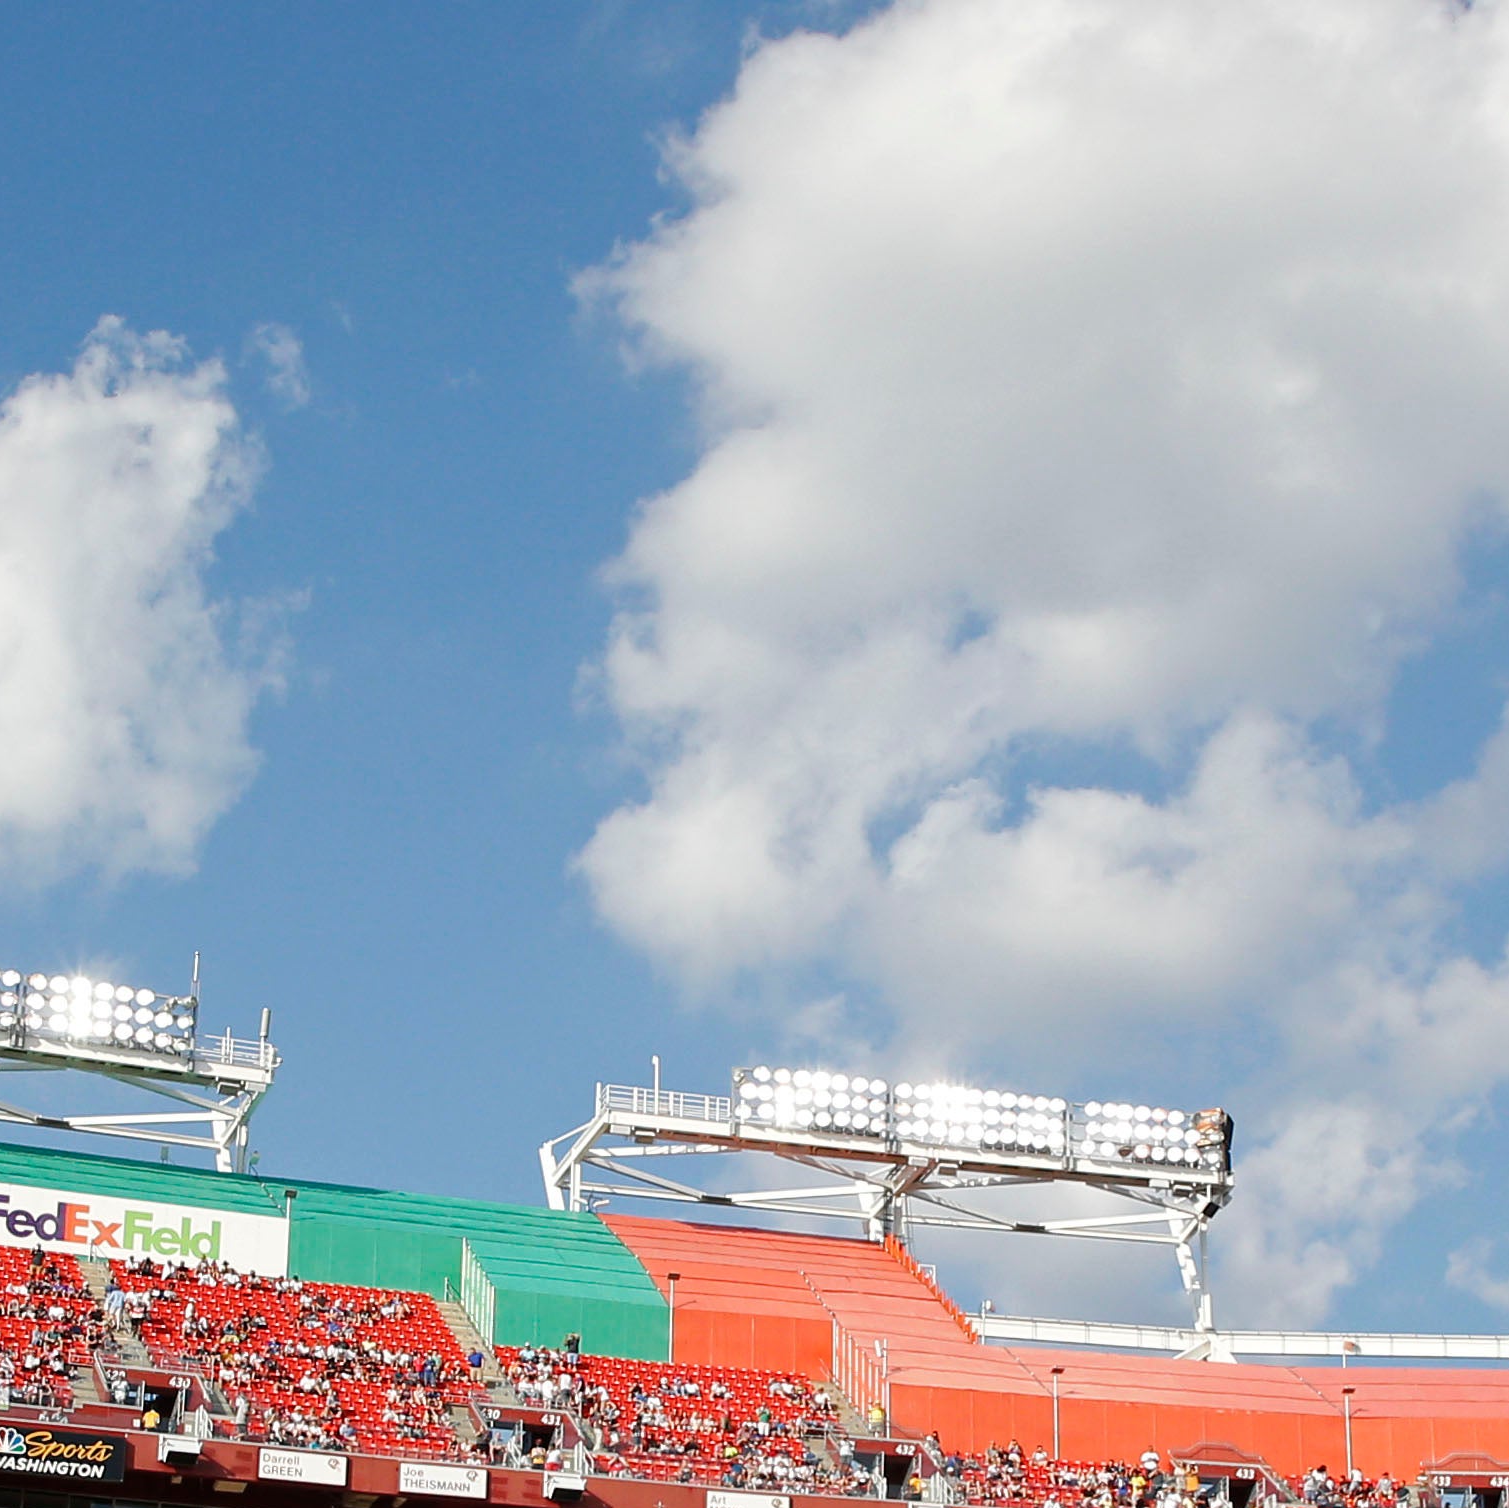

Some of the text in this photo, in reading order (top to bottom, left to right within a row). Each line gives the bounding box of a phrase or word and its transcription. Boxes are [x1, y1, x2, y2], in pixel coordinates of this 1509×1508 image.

[168, 1375, 191, 1389] 430
[540, 1414, 564, 1427] 431
[26, 1431, 115, 1462] Sports
[895, 1444, 917, 1457] 432
[262, 1451, 300, 1466] Darrell
[262, 1463, 304, 1479] GREEN
[403, 1466, 425, 1477] Joe
[403, 1476, 472, 1493] THEISMANN
